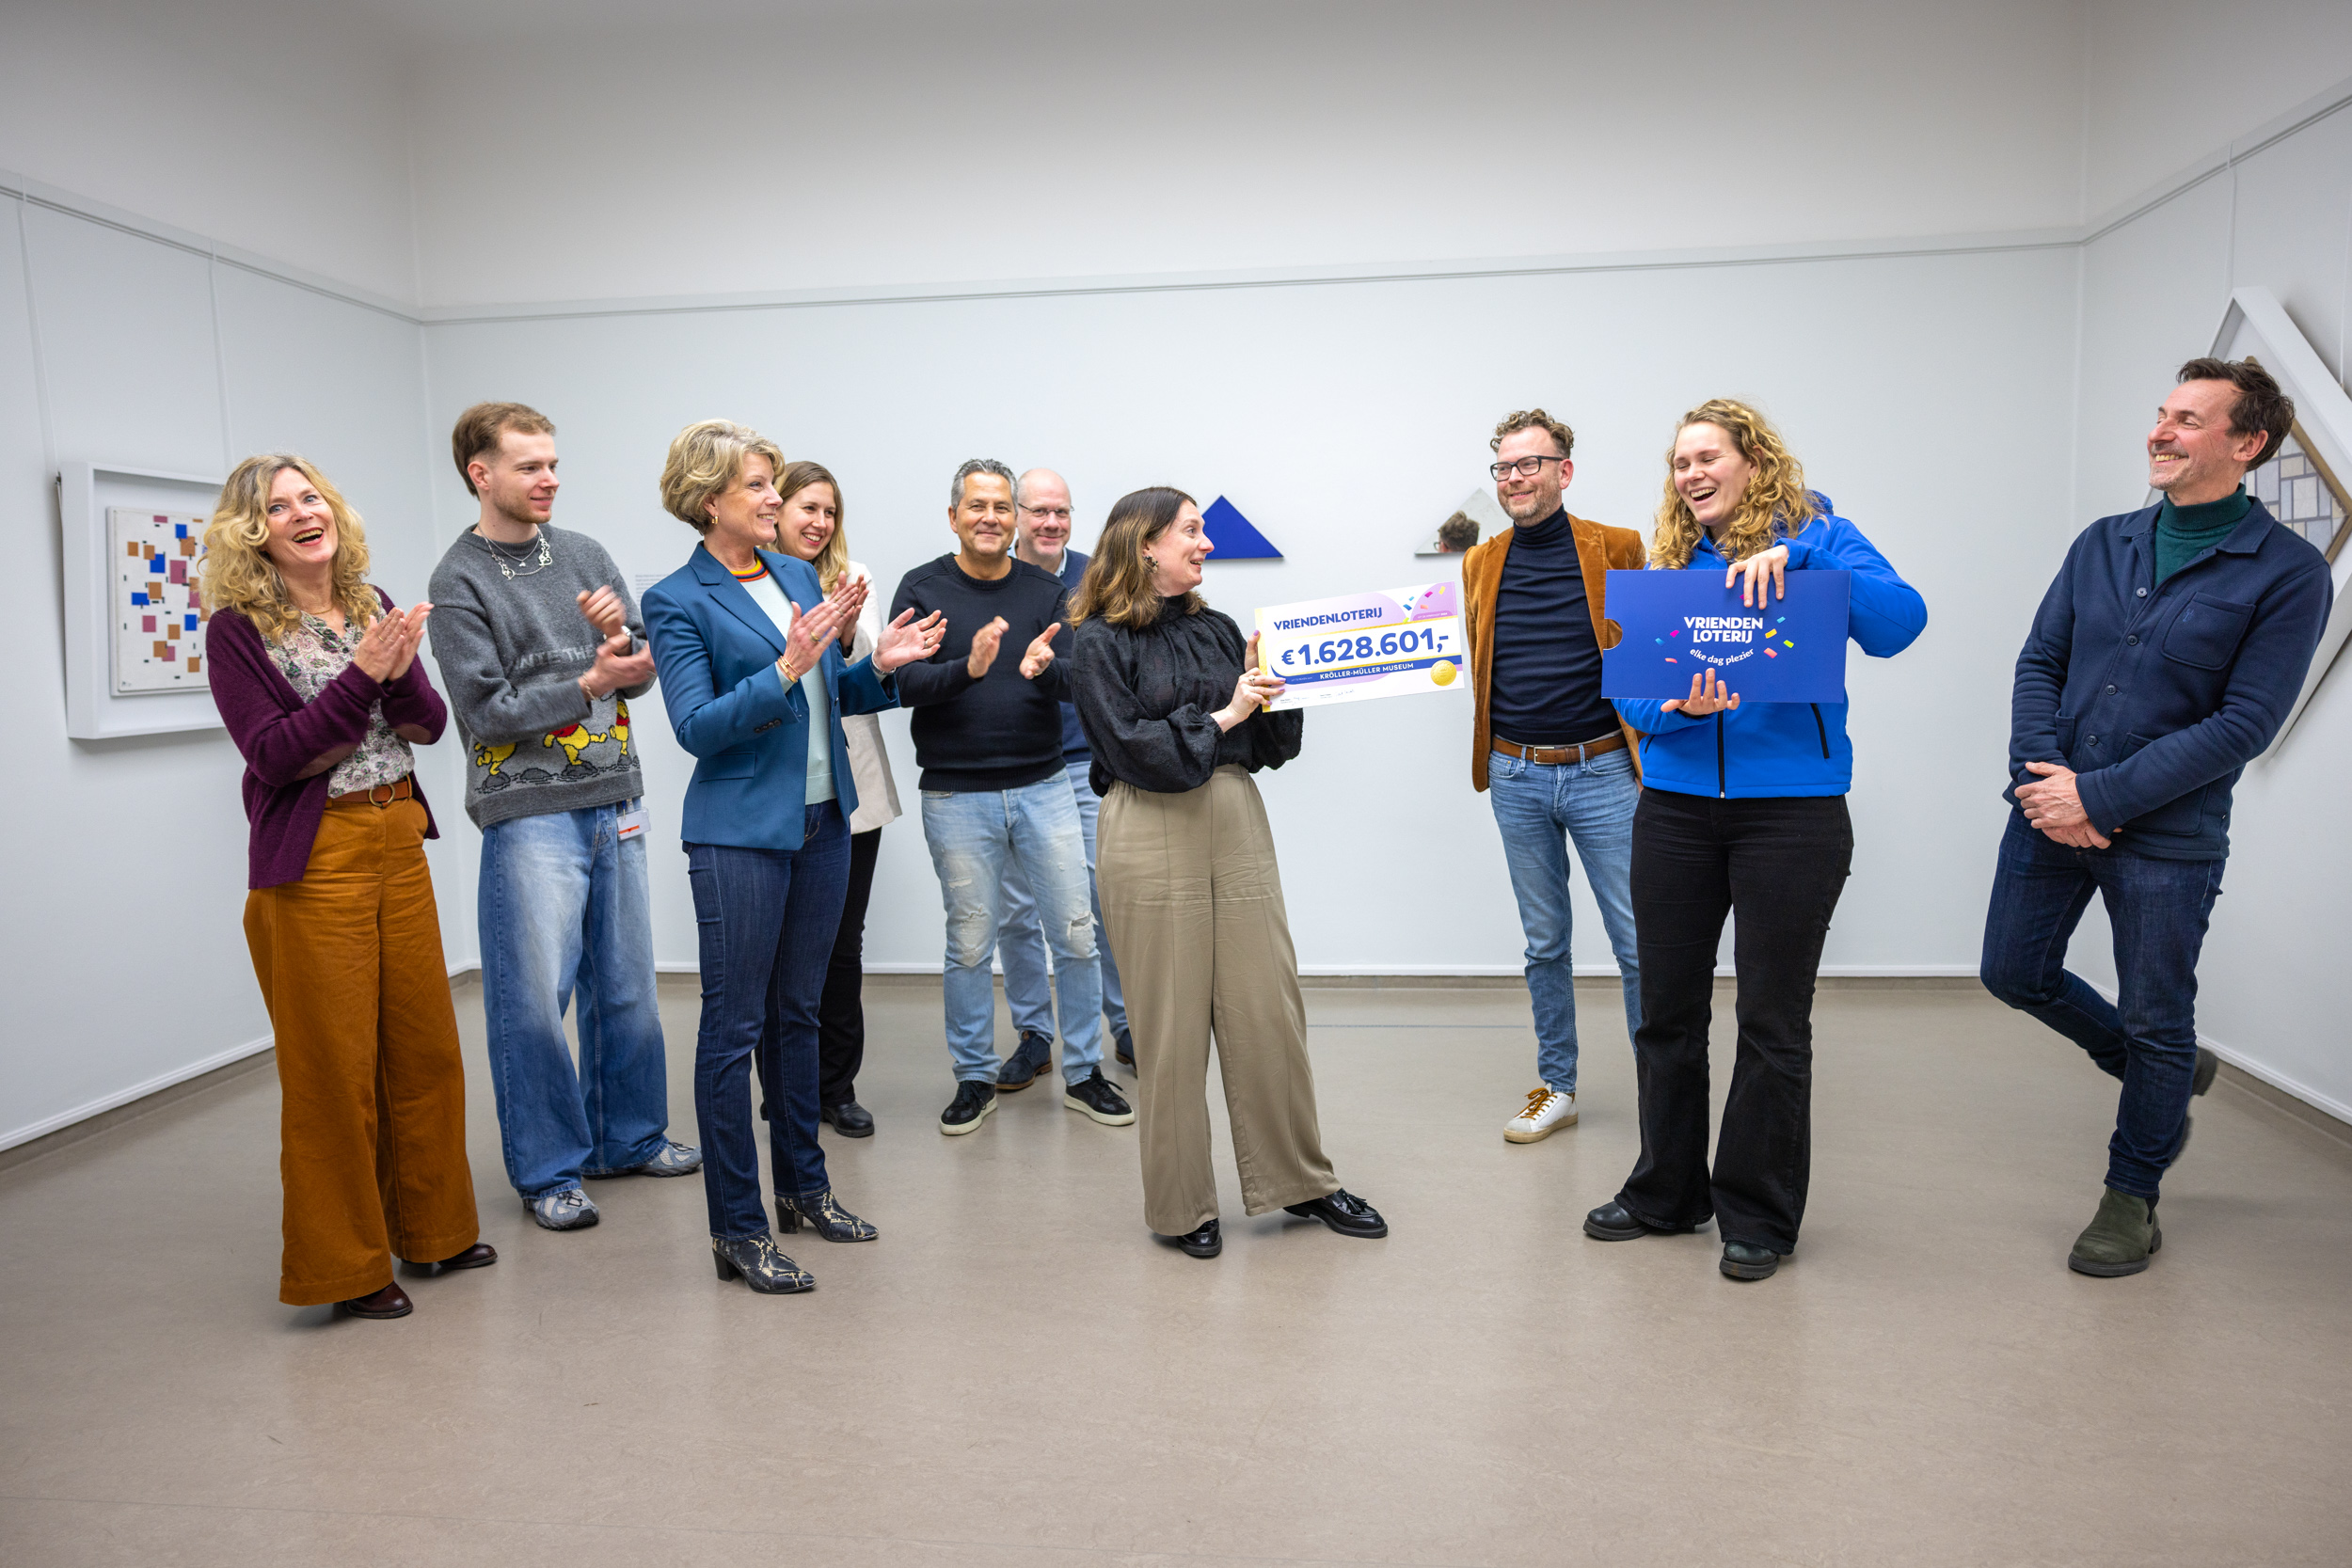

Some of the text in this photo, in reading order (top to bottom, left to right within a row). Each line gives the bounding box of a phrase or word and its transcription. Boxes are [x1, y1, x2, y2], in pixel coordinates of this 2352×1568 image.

[1274, 607, 1383, 631] VRIENDENLOTERIJ
[1684, 616, 1763, 630] VRIENDEN
[1692, 629, 1754, 643] LOTERIJ
[1690, 648, 1755, 666] elke dag plezier
[1319, 666, 1381, 680] KRÖLLER-MÜLLER
[1382, 662, 1414, 673] MUSEUM
